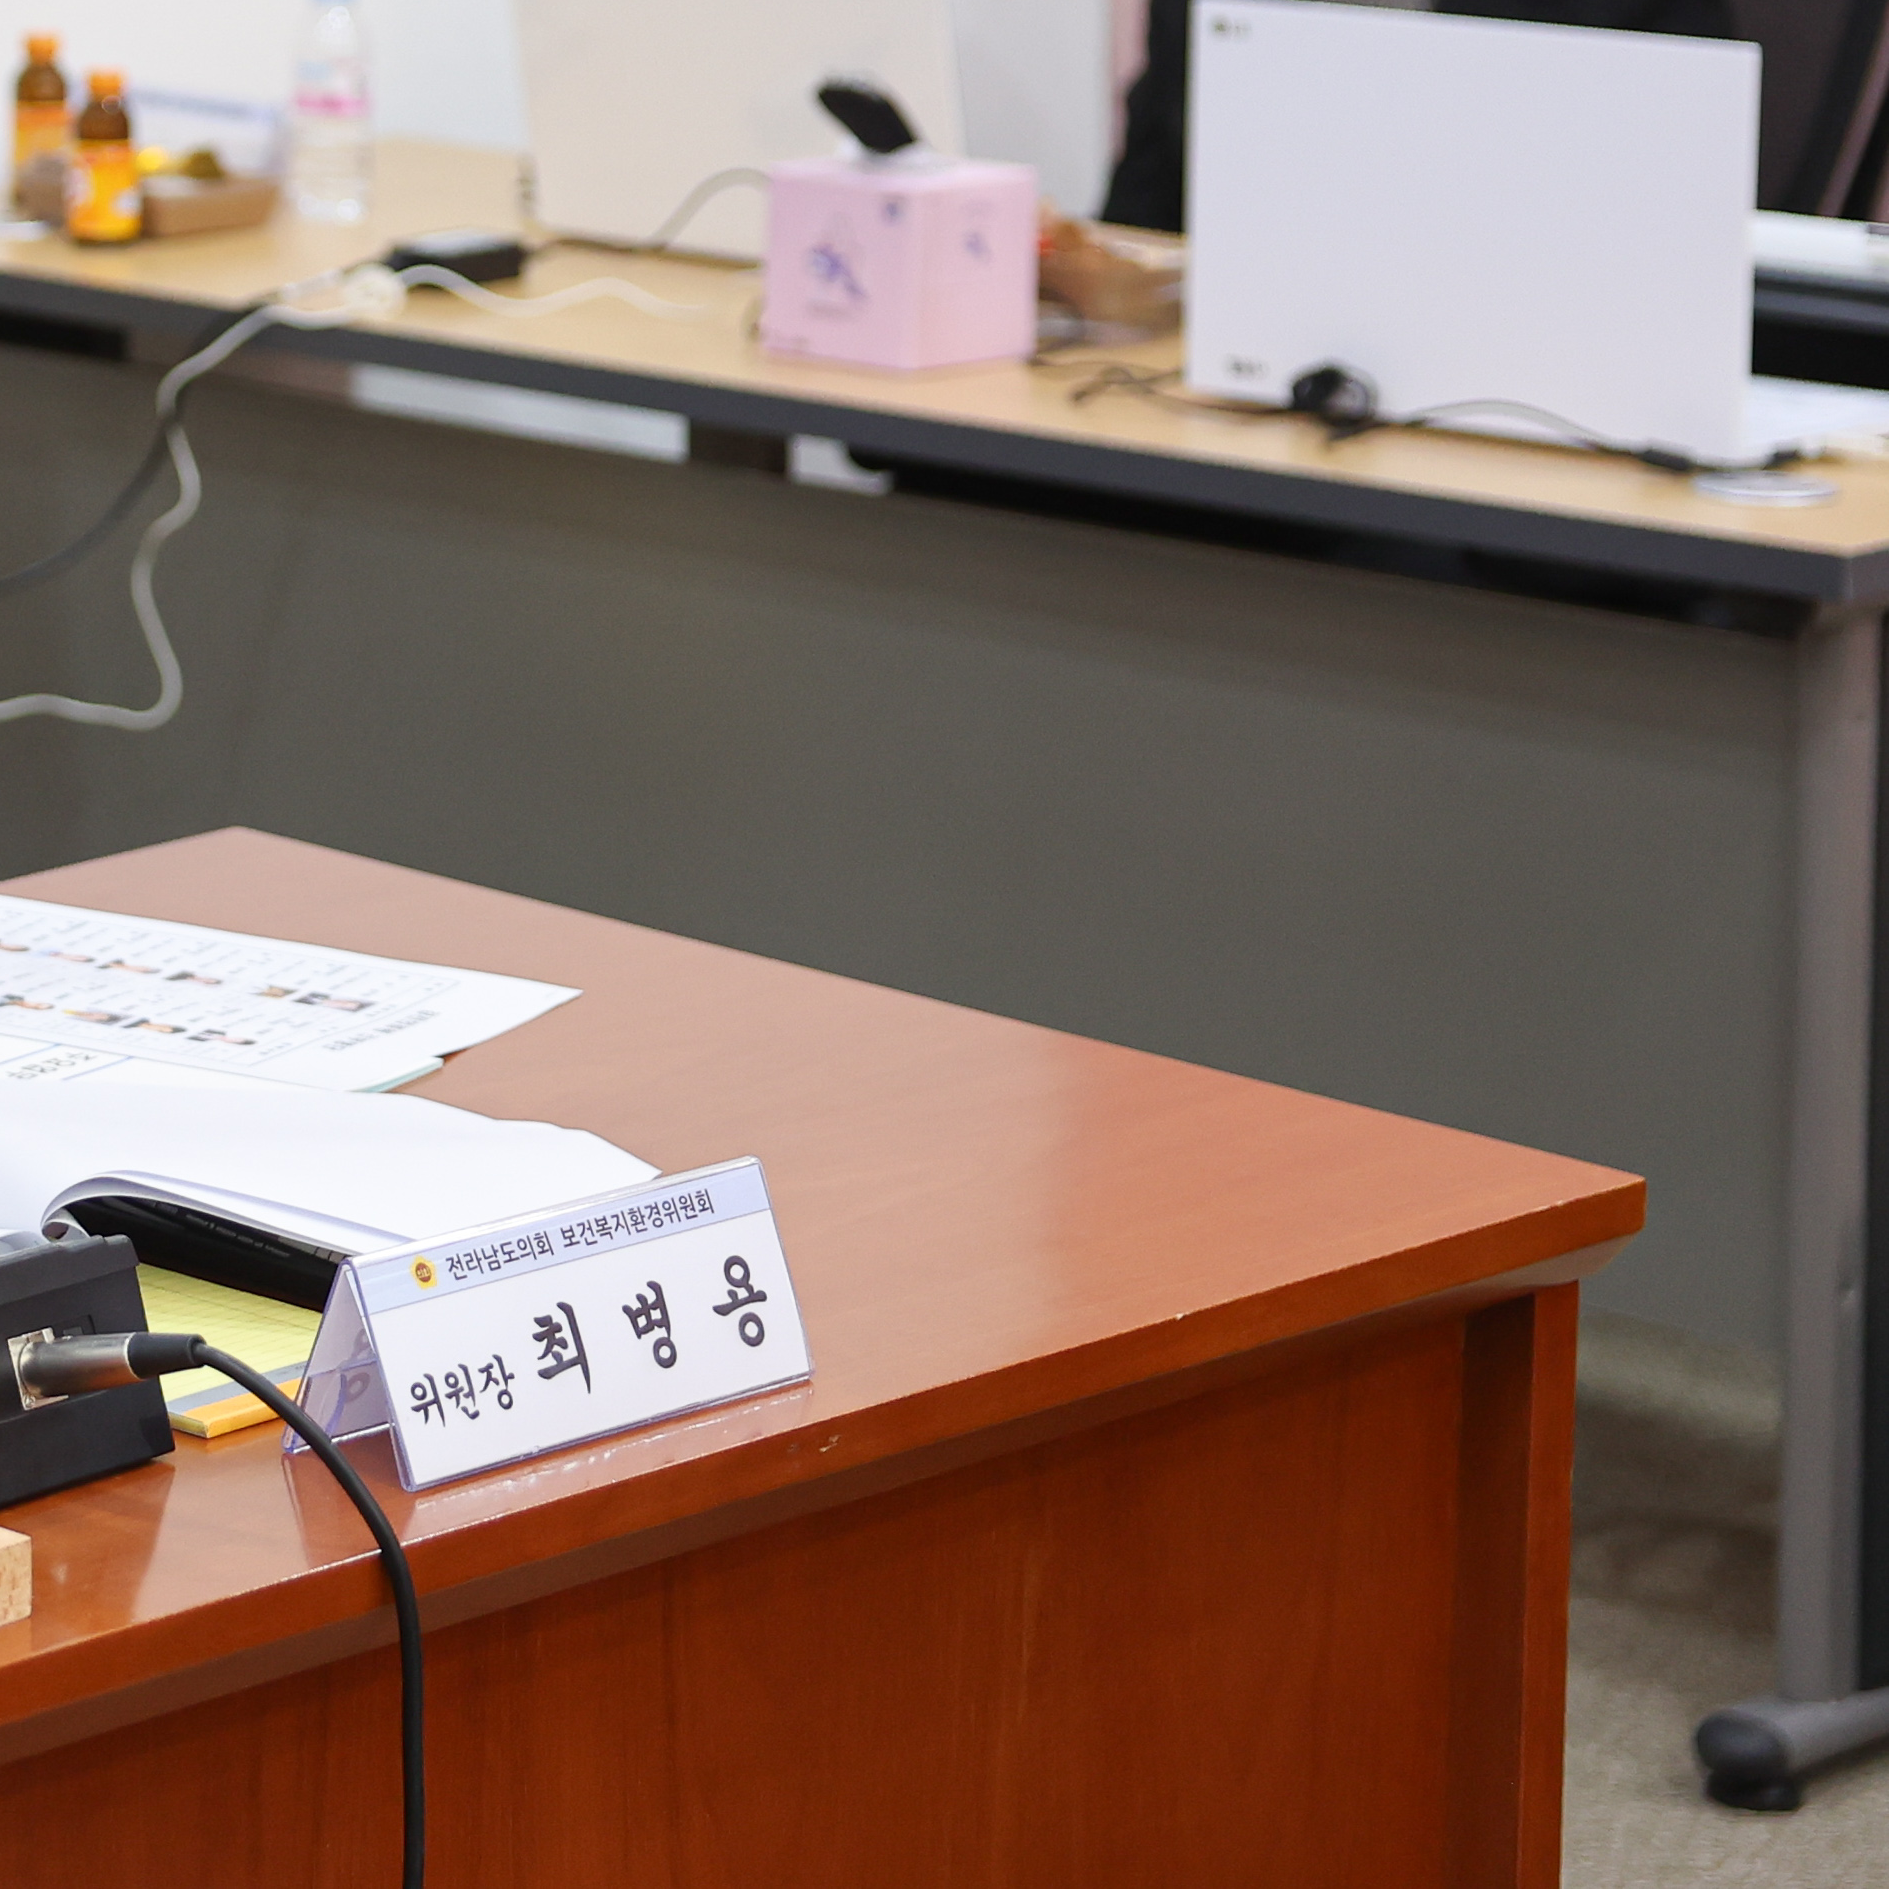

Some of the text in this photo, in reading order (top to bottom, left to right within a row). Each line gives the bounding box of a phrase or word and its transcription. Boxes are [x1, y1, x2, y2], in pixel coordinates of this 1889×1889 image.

[446, 1230, 555, 1281] 전라남도의회
[559, 1187, 716, 1250] 보건복지환경위원회
[409, 1353, 516, 1428] 위원장
